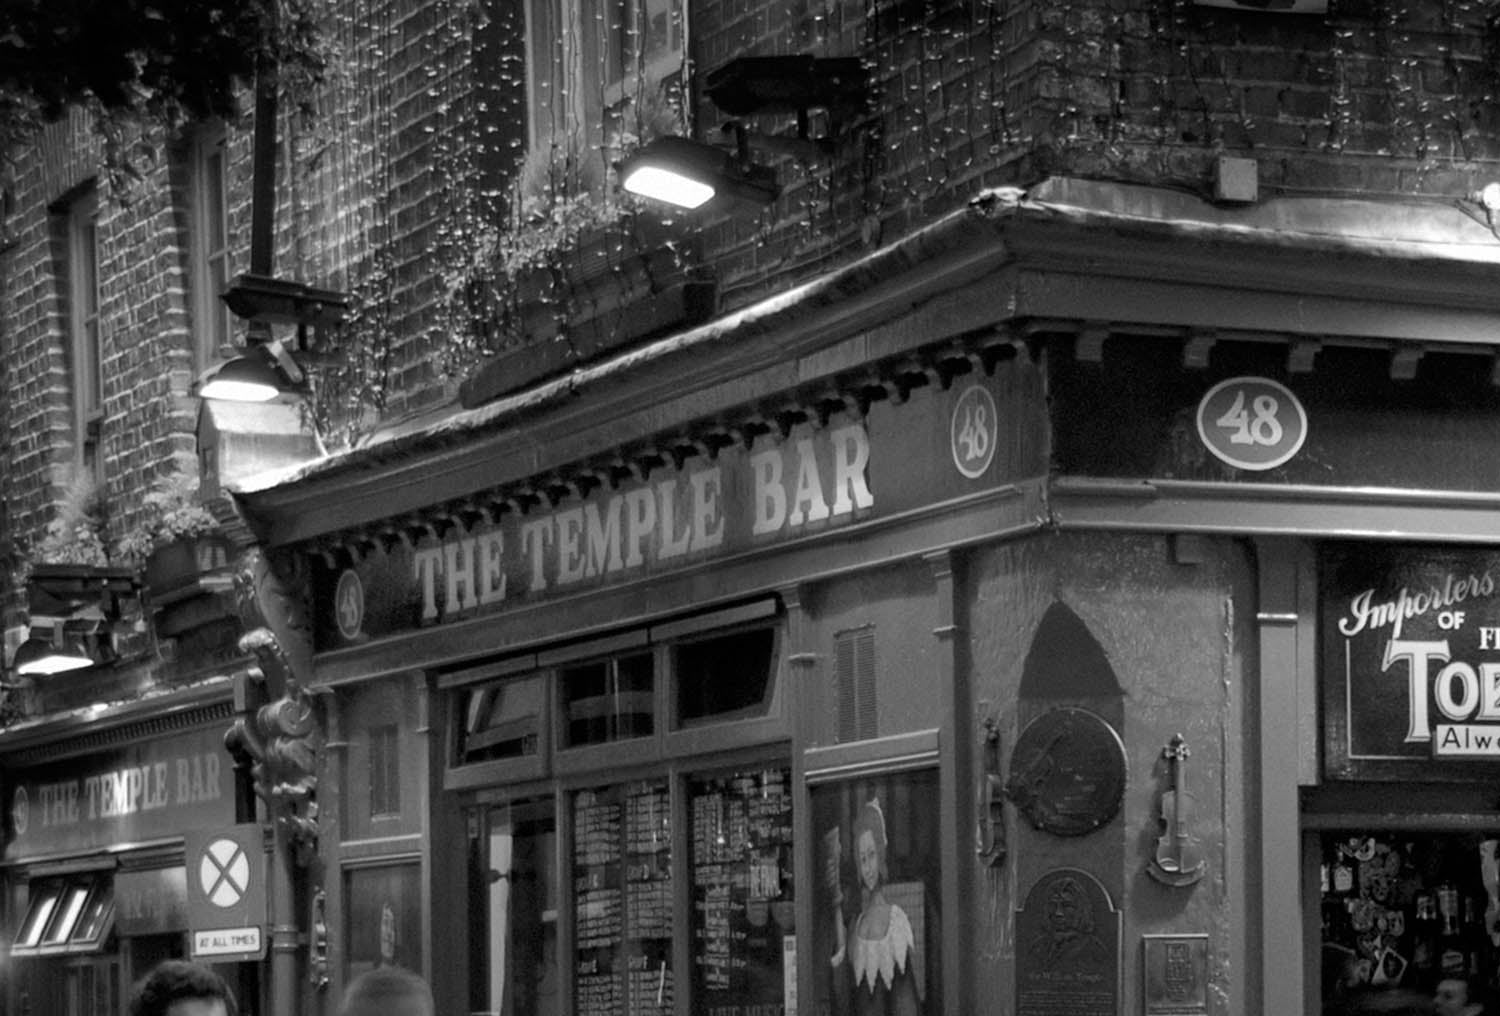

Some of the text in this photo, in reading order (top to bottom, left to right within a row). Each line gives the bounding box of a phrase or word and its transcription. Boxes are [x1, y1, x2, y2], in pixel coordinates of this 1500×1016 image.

[959, 404, 989, 461] 48
[1216, 391, 1282, 446] 48
[415, 424, 873, 620] THE TEMPLE BAR
[1339, 571, 1495, 639] Importers
[1438, 611, 1466, 630] OF
[39, 781, 80, 826] THE
[85, 762, 168, 820] TEMPLE
[176, 753, 221, 806] BAR
[212, 936, 227, 947] ALL
[231, 934, 256, 945] TIMES
